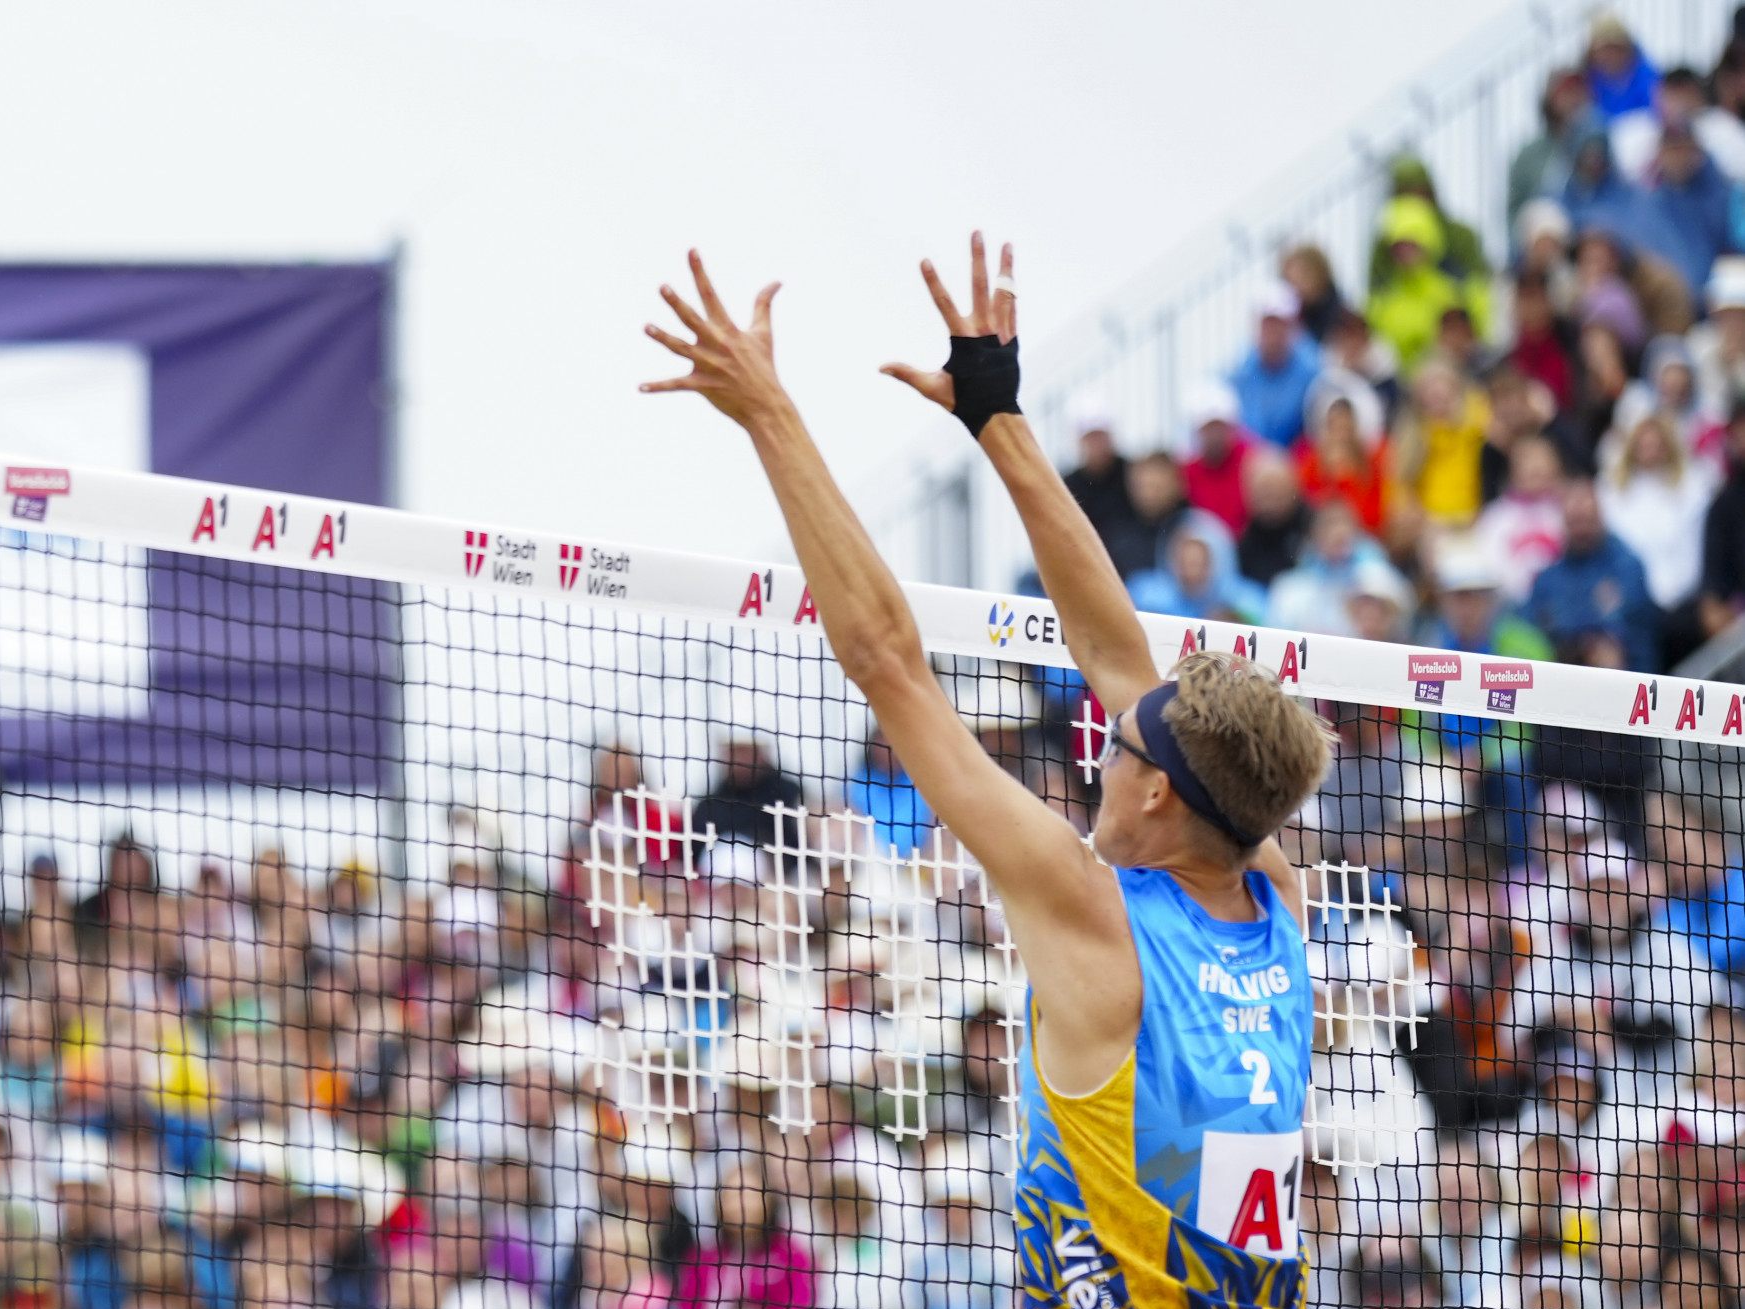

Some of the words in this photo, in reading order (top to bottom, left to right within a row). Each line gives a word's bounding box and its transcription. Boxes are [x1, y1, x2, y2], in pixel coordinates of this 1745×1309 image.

[192, 494, 227, 542] A1
[252, 503, 286, 551] A1
[311, 510, 346, 559] A1
[496, 535, 536, 560] Stadt
[590, 548, 630, 574] Stadt
[493, 561, 533, 586] Wien
[587, 574, 627, 598] Wien
[738, 568, 774, 618] A1
[794, 584, 817, 625] A
[1025, 614, 1067, 646] CE
[1278, 637, 1308, 683] A1
[1412, 662, 1458, 674] Vorteilsclub
[1484, 671, 1530, 683] Vorteilsclub
[1628, 679, 1658, 726] A1
[1675, 684, 1705, 731] A1
[1722, 693, 1745, 736] A
[1222, 1005, 1272, 1033] SWE
[1240, 1049, 1277, 1104] 2
[1227, 1154, 1299, 1251] A1
